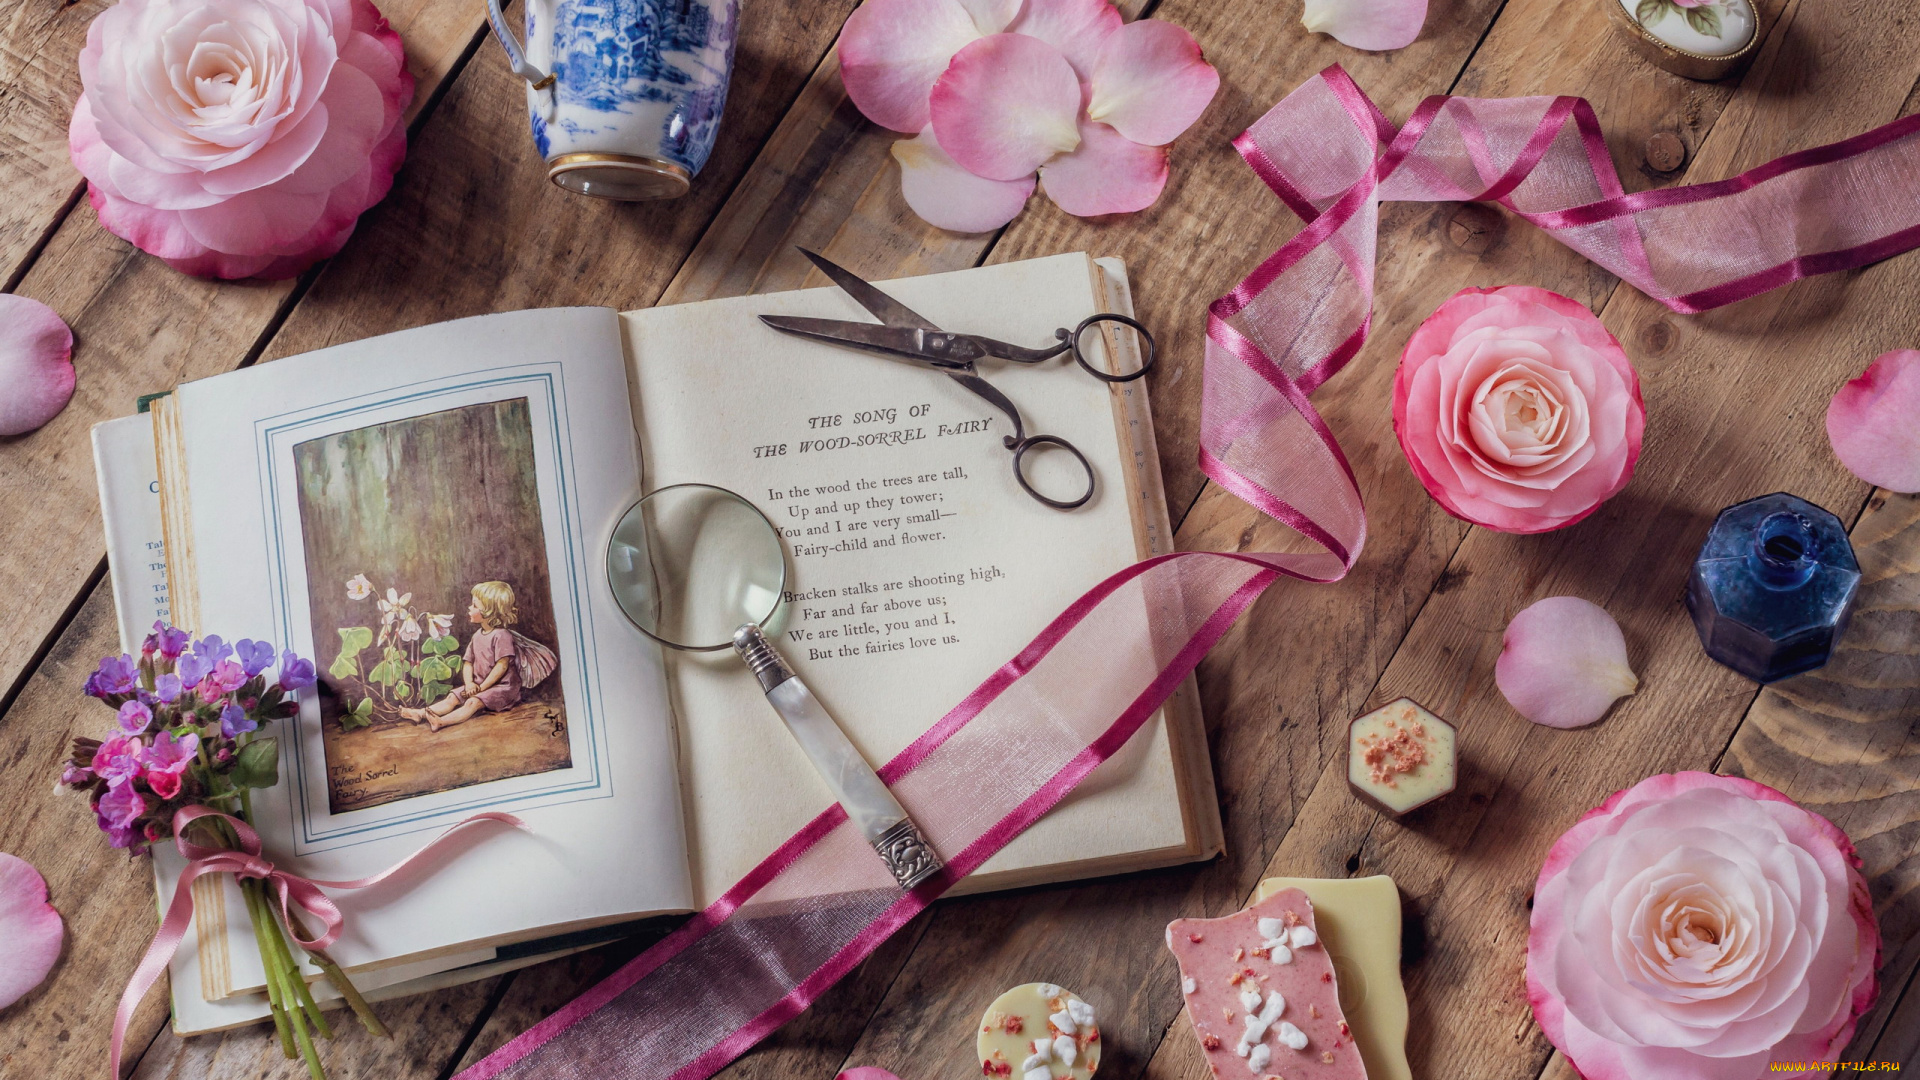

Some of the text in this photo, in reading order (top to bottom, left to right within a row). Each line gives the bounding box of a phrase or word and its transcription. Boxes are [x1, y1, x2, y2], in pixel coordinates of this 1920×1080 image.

[808, 404, 930, 429] THE SONG OF
[753, 417, 992, 458] THE WOOD-SORREL FAIRY
[768, 467, 968, 500] In the wood the trees are tall,
[788, 493, 943, 520] Up and up they tower;
[775, 526, 801, 539] You
[807, 522, 829, 535] and
[835, 521, 841, 532] I
[848, 522, 867, 531] are
[873, 518, 900, 530] very
[794, 532, 945, 557] Fairy-child and flower.
[783, 565, 1005, 603] Bracken stalks are shooting high,
[803, 597, 946, 620] Far and far above us;
[788, 612, 955, 641] We are little, you and I,
[809, 635, 959, 660] But the fairies love us.
[332, 763, 355, 776] The
[333, 763, 399, 788] Wood Sorrel
